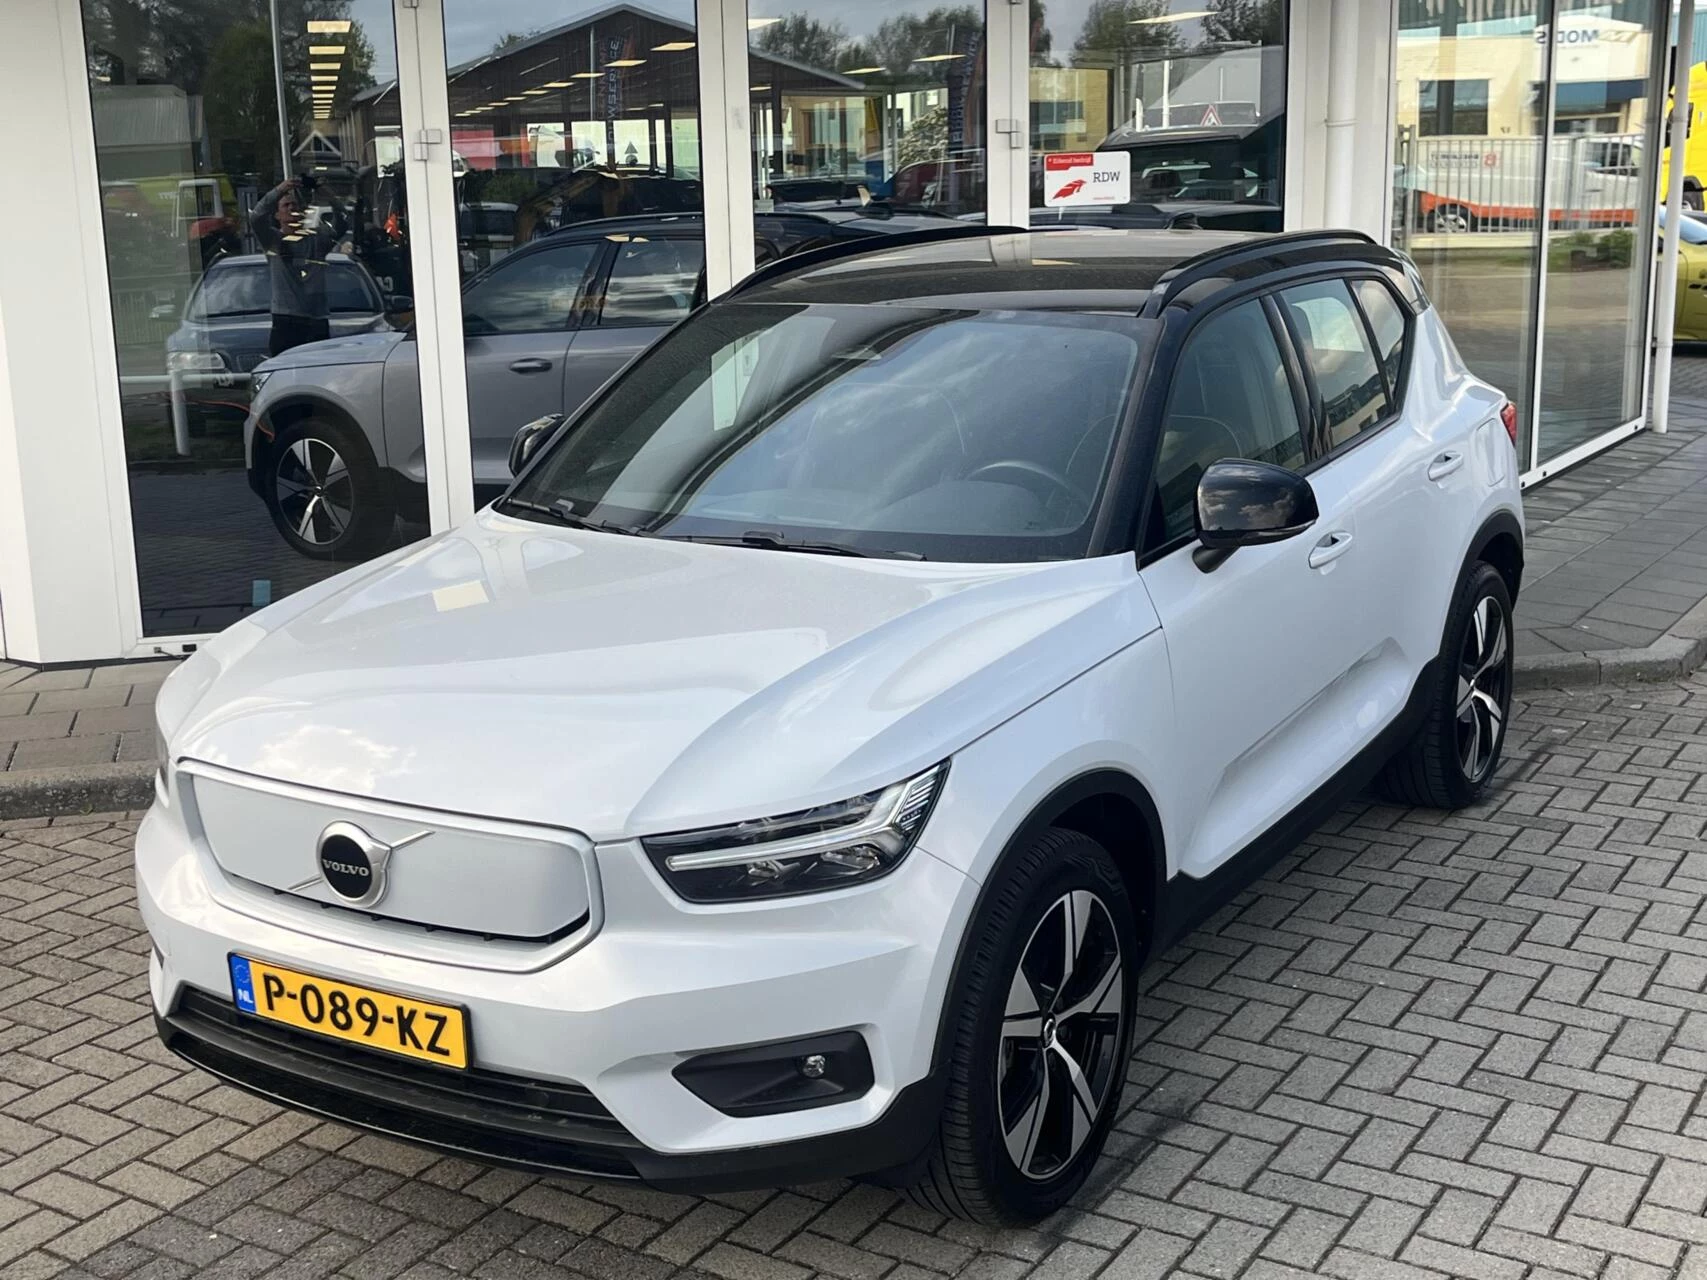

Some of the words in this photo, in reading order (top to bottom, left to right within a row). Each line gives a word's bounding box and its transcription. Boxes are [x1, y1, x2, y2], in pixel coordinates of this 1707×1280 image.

[1093, 171, 1120, 183] RDW
[322, 858, 370, 877] VOLVO
[237, 988, 254, 1004] NL
[262, 971, 450, 1057] P-089-KZ
